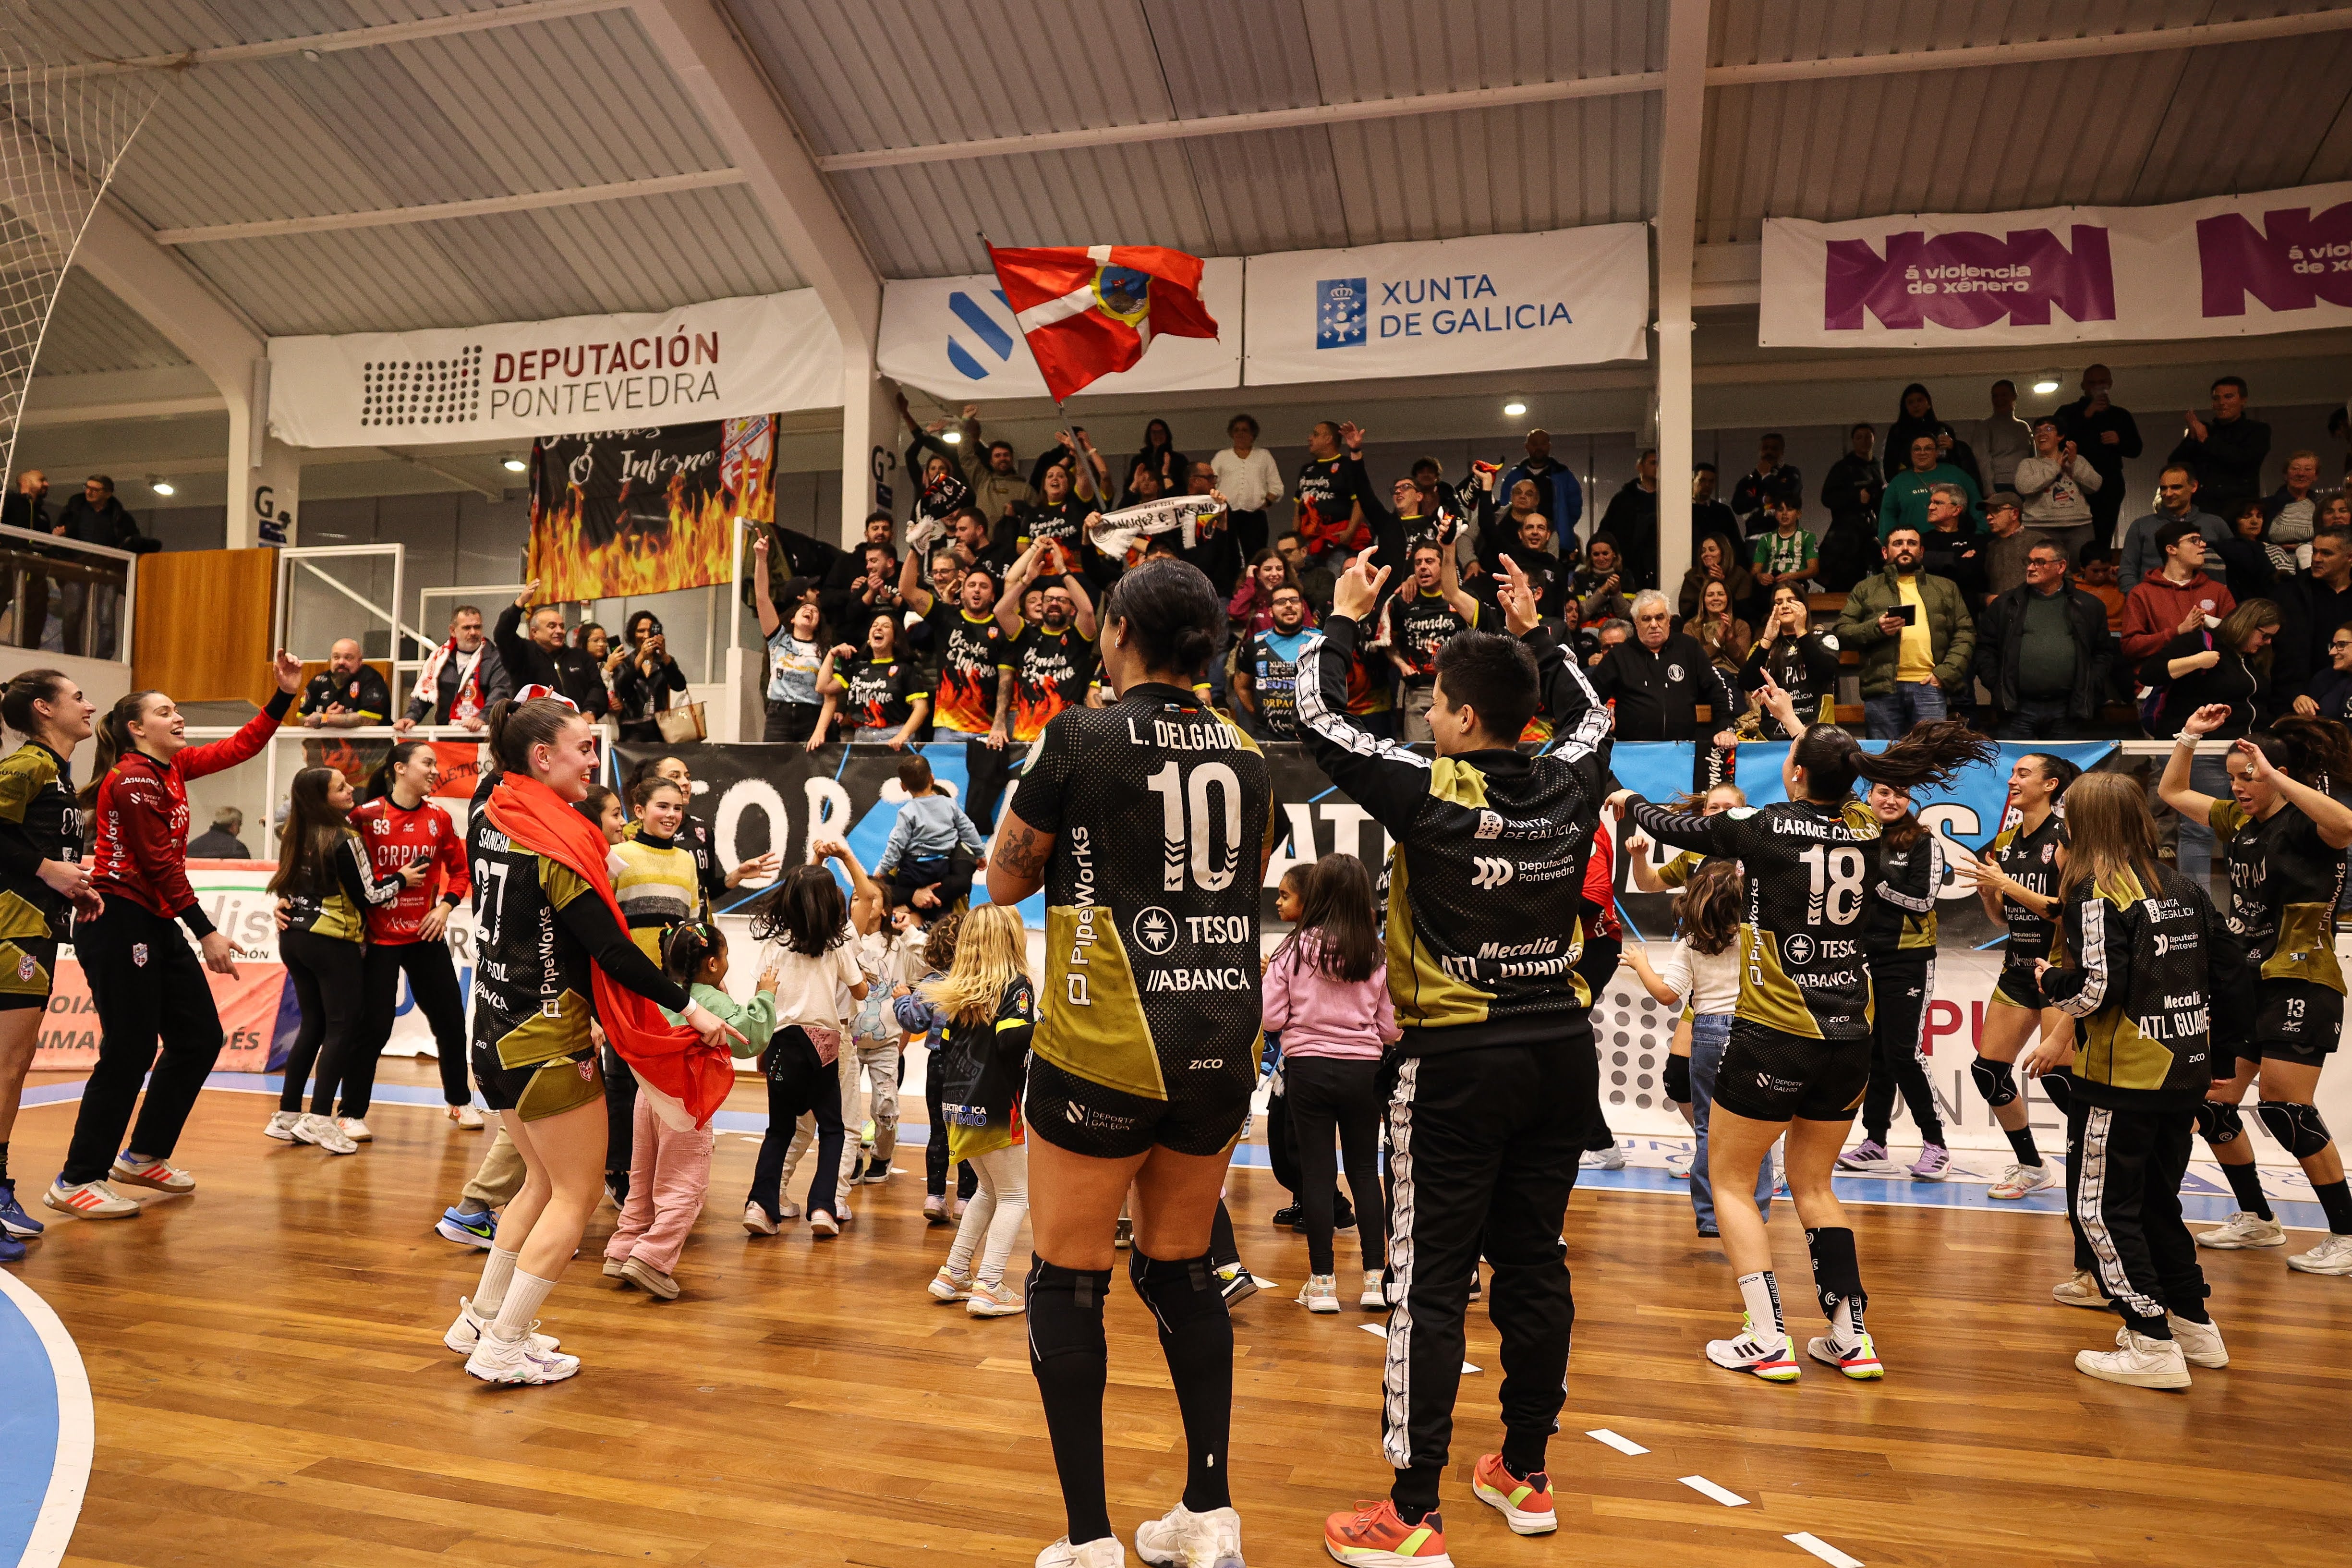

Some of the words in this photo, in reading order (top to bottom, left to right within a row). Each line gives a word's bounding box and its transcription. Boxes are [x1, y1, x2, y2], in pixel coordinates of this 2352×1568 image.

[2309, 241, 2352, 258] vio
[1824, 224, 2116, 330] NON
[1926, 264, 2032, 279] violencia
[2293, 261, 2325, 274] de
[1382, 274, 1497, 305] XUNTA
[1907, 280, 1938, 294] de
[1943, 277, 2029, 293] xénero
[1381, 312, 1422, 338] DE
[1433, 302, 1573, 334] GALICIA
[493, 324, 718, 383] DEPUTACIÓN
[491, 370, 720, 419] PONTEVEDRA
[618, 449, 719, 485] Inferno
[1127, 717, 1150, 745] L.
[1154, 719, 1242, 751] DELGADO
[373, 819, 391, 835] 93
[1147, 760, 1241, 892] 10
[1503, 831, 1526, 840] DE
[1528, 821, 1581, 841] GALICIA
[1504, 817, 1552, 828] XUNTA
[1773, 816, 1831, 839] CARME
[1518, 865, 1575, 882] Pontevedra
[1799, 843, 1866, 926] 18
[473, 857, 509, 946] 27
[1477, 936, 1558, 960] Mecalia
[2286, 998, 2305, 1018] 13
[1829, 1015, 1850, 1023] ZICO
[2138, 1015, 2173, 1040] ATL.
[1188, 1058, 1223, 1070] ZICO
[2189, 1053, 2205, 1063] ZICO
[1773, 1084, 1798, 1093] GALEGO
[1775, 1078, 1804, 1088] DEPORTE
